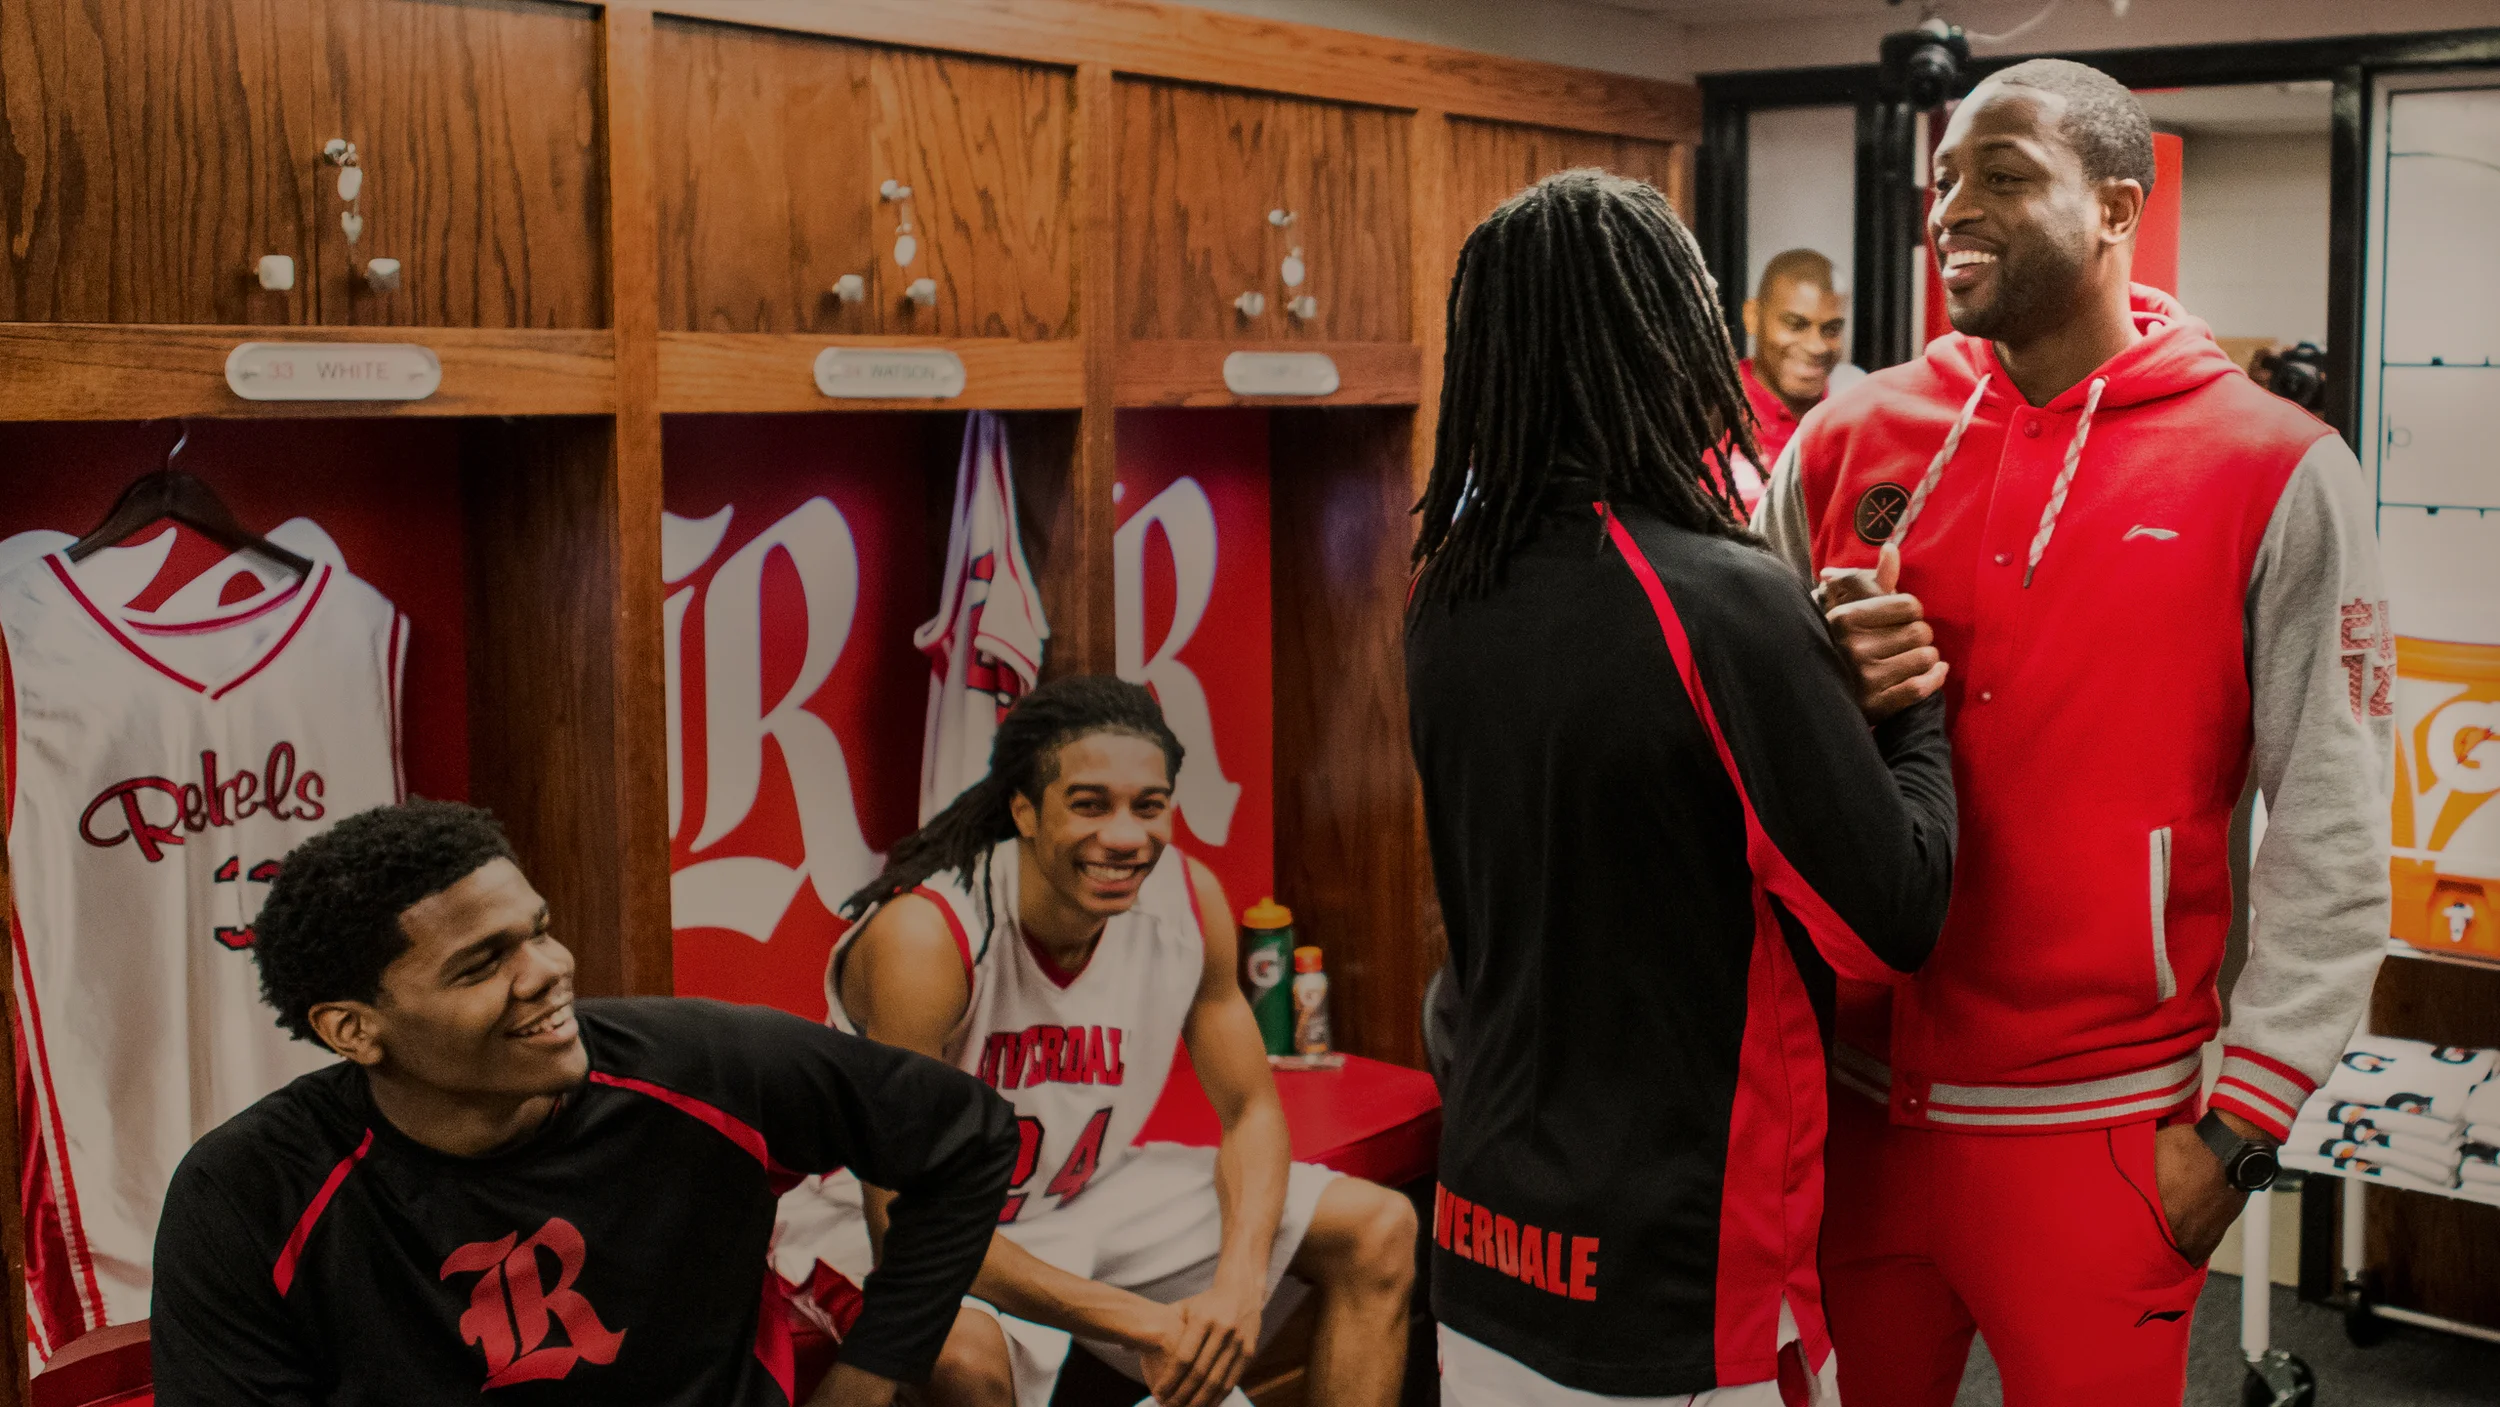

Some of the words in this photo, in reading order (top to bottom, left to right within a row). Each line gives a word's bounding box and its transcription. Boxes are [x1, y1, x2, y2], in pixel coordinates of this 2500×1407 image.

[267, 361, 295, 380] 33
[316, 361, 391, 381] WHITE
[78, 740, 325, 862] Rebels
[976, 1023, 1125, 1090] IVERDAL
[1433, 1180, 1600, 1302] VERDALE
